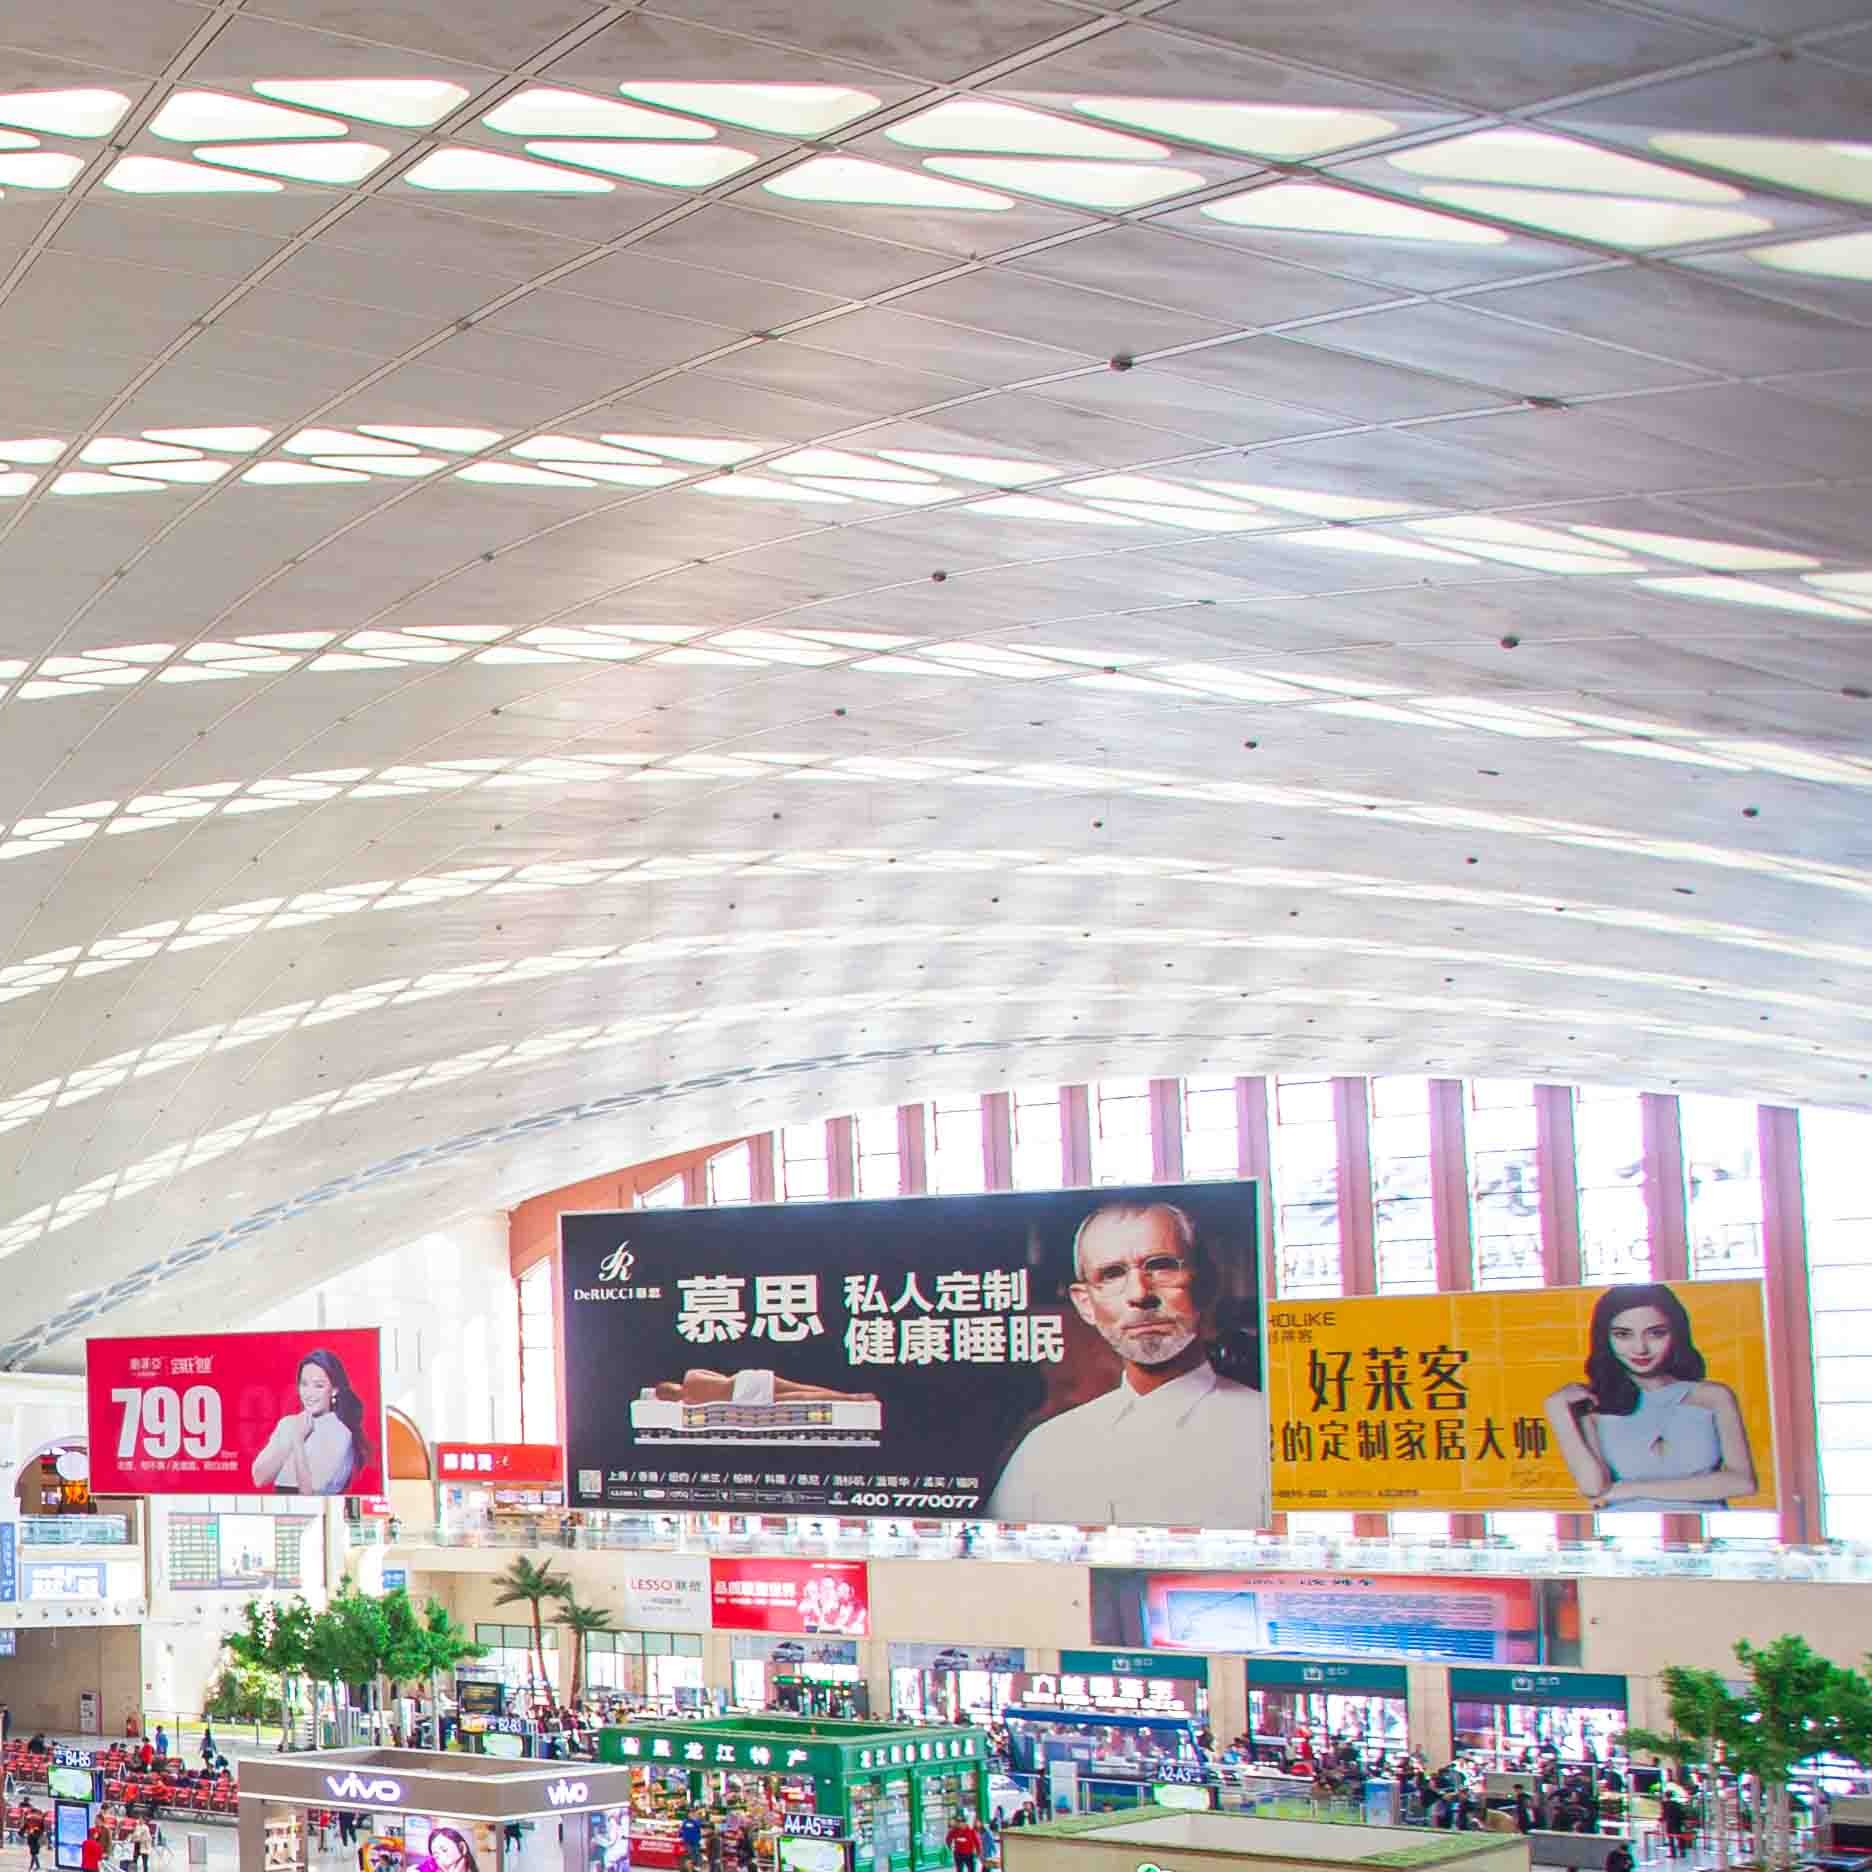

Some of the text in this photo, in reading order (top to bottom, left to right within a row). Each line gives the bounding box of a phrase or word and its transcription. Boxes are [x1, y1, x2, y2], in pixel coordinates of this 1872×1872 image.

[574, 1288, 633, 1301] DeRUCCI
[676, 1269, 1029, 1343] 慕思 私人定制
[843, 1315, 1065, 1367] 健康睡眠
[1308, 1345, 1469, 1412] 好莱客
[111, 1385, 223, 1460] 799
[851, 1493, 980, 1509] 400 7770077
[631, 1579, 672, 1592] LESSO
[326, 1772, 401, 1802] vivo
[547, 1778, 588, 1806] vivo
[784, 1814, 821, 1836] A4-A5
